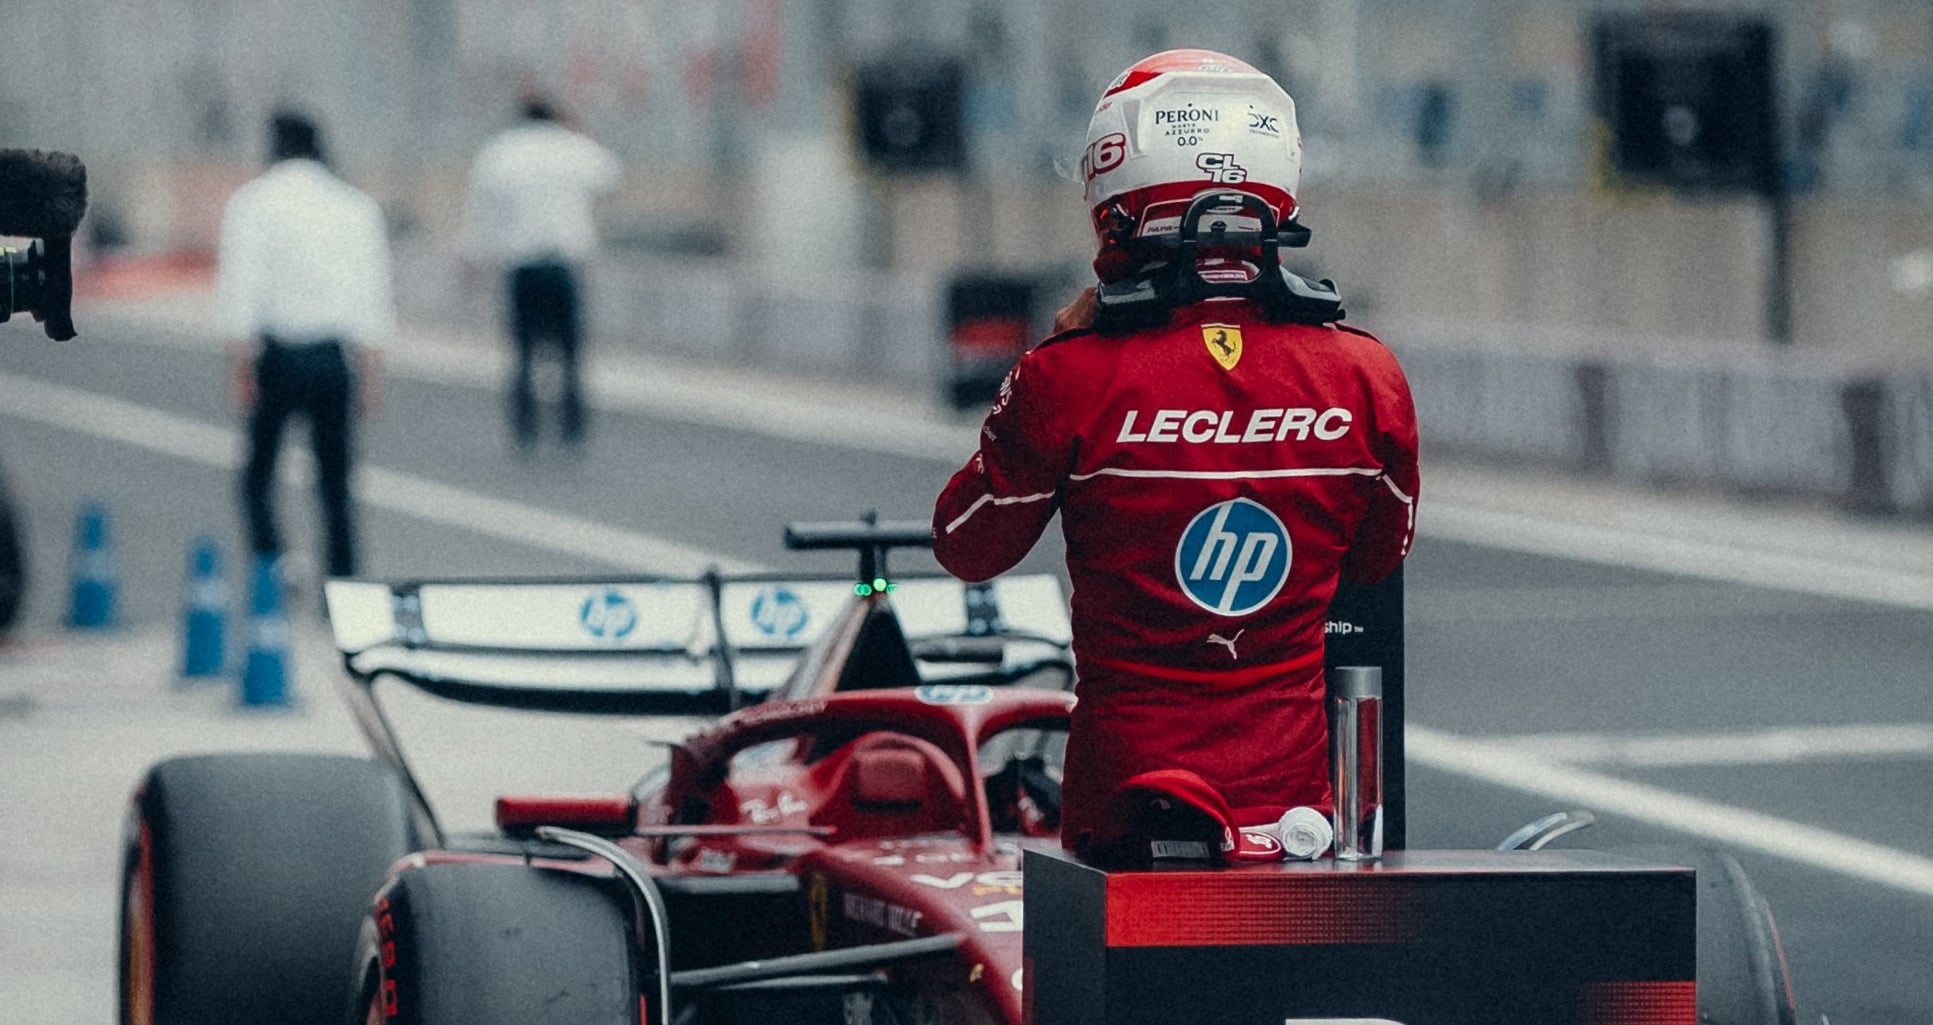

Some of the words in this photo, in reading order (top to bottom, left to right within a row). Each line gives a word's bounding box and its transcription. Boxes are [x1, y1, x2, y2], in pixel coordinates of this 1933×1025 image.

[1155, 108, 1219, 125] PERONI
[1248, 112, 1279, 133] DXC
[1082, 132, 1126, 181] 16
[1196, 152, 1241, 171] CL
[1204, 168, 1248, 184] 16
[1115, 407, 1353, 444] LECLERC
[1182, 499, 1286, 615] hp
